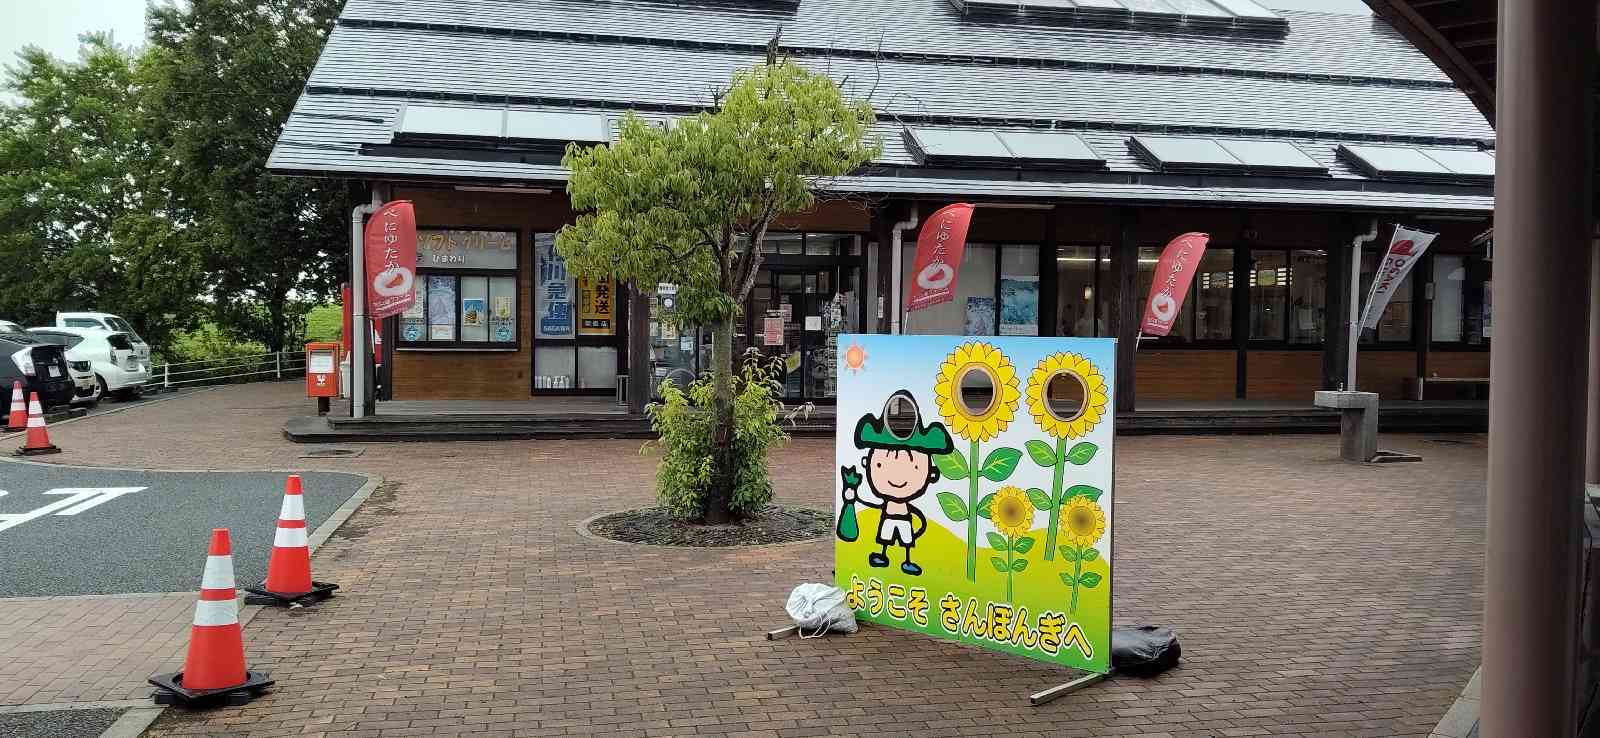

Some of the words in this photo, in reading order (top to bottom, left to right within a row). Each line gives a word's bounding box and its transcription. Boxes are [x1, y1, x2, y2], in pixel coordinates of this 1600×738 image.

[846, 576, 930, 626] ようこそ
[940, 594, 1094, 660] さんぼんぎへ
